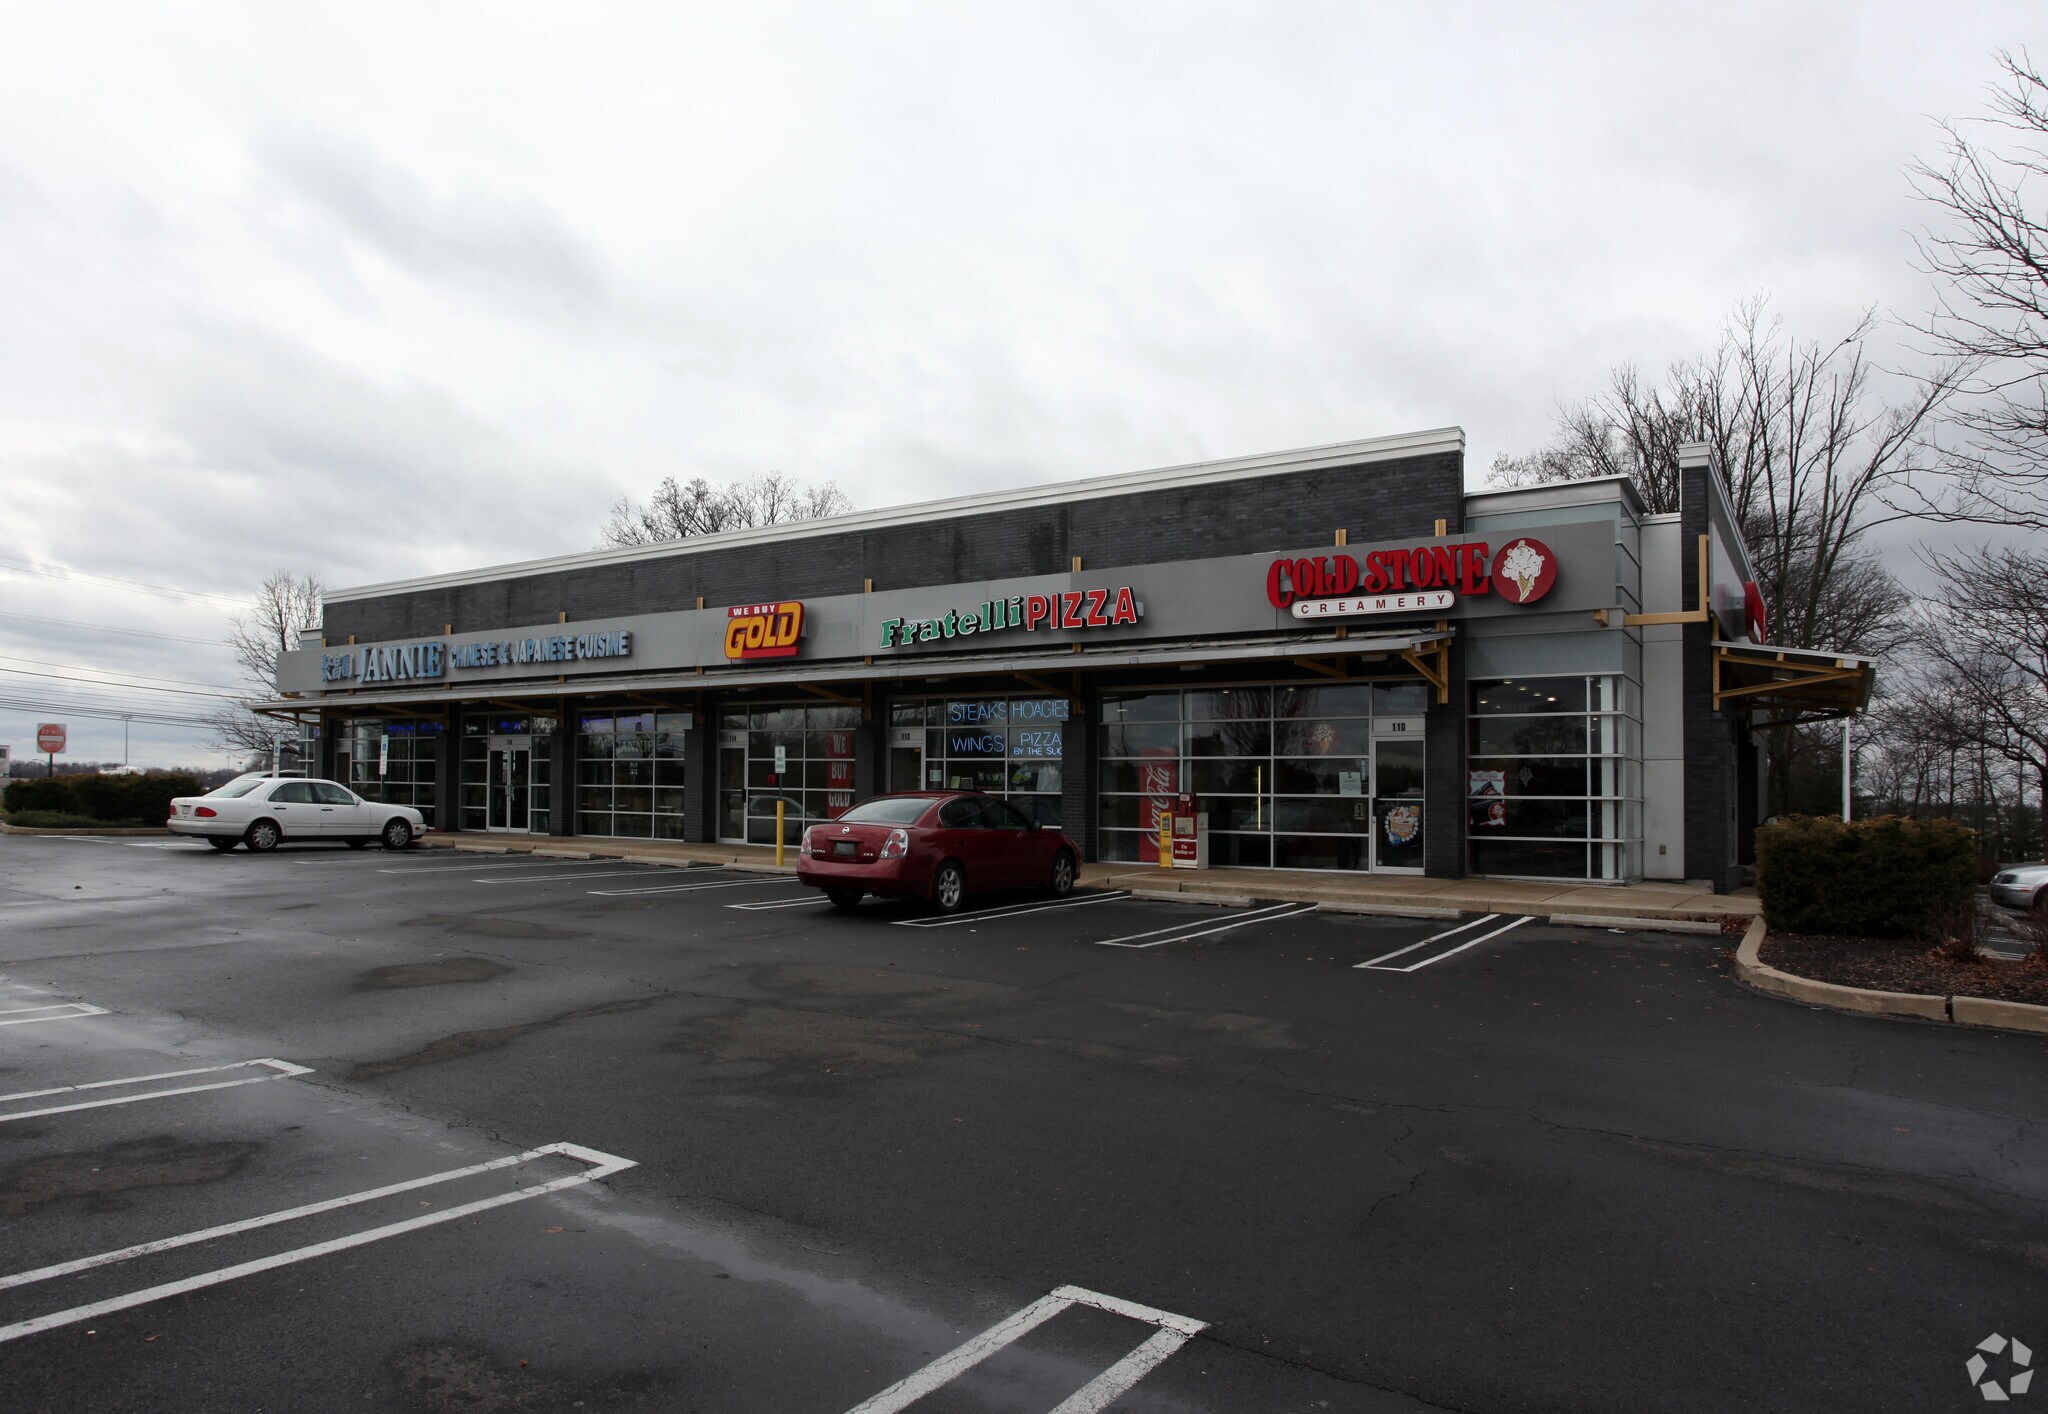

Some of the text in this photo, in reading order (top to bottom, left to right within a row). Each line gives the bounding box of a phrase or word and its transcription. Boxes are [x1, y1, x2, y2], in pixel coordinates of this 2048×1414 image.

[1267, 542, 1489, 609] COLD STONE
[733, 604, 775, 616] WE BUY
[1300, 594, 1446, 615] CREAMERY
[879, 586, 1138, 648] Fratelli PIZZA
[725, 601, 803, 659] GOLD
[356, 630, 631, 684] JANNIE CHINESE & JAPANESE CUISINE
[951, 699, 1069, 721] STEAKS HOAGIES
[1391, 722, 1406, 732] 110
[832, 734, 847, 754] WE
[952, 732, 1062, 753] WINGS PIZZA
[1013, 747, 1063, 756] BY THE SLIC
[831, 762, 847, 780] BUY
[828, 788, 851, 807] GOLD
